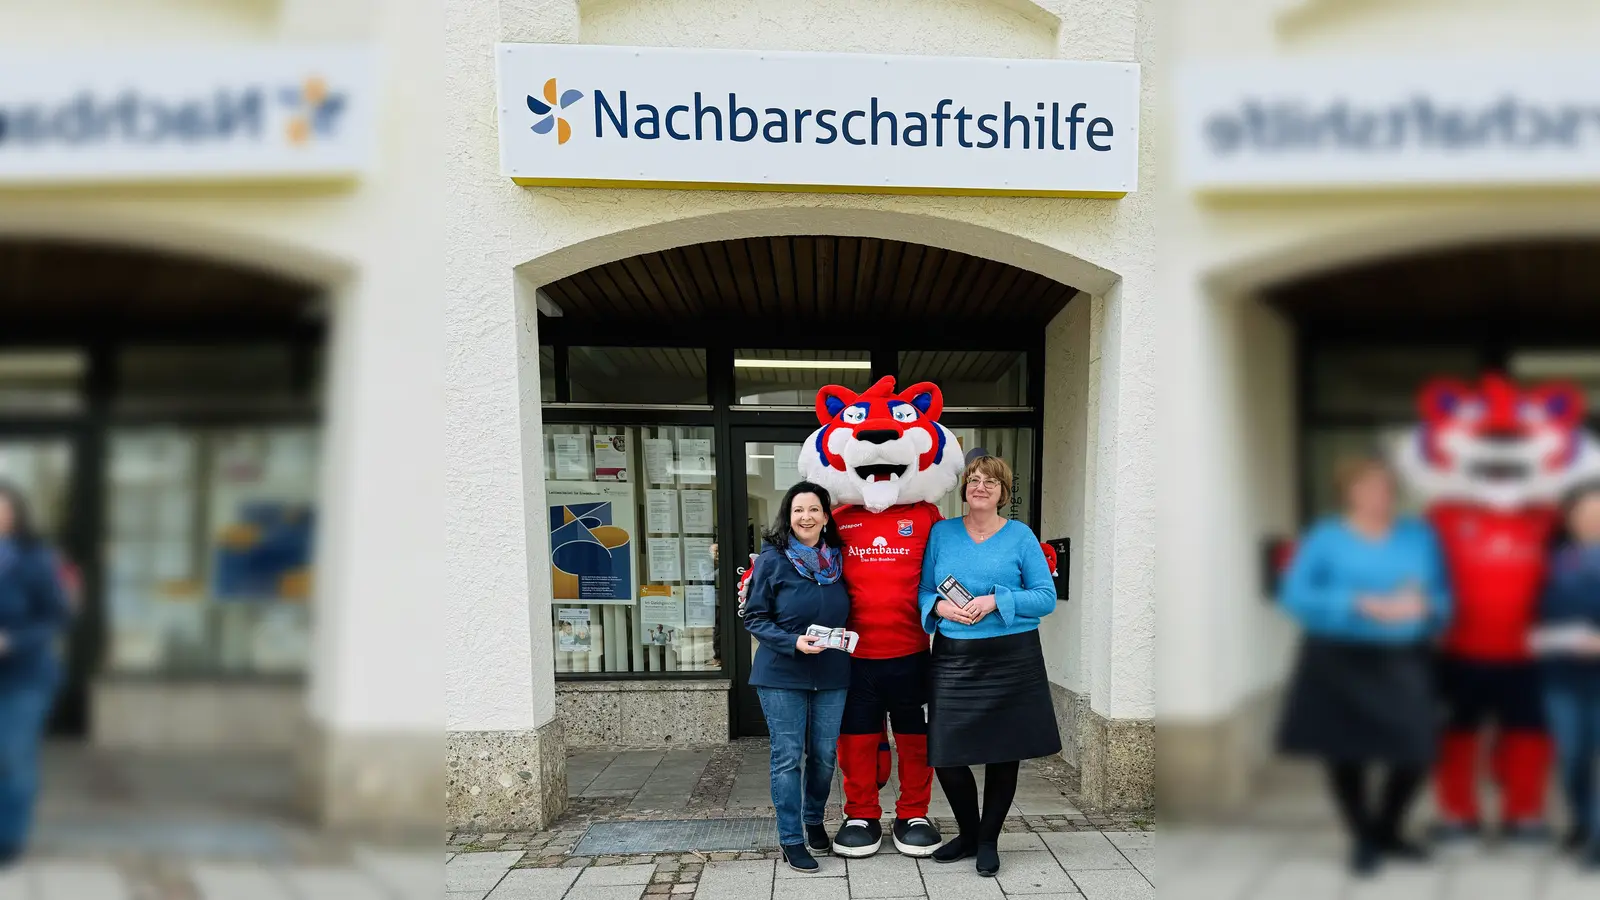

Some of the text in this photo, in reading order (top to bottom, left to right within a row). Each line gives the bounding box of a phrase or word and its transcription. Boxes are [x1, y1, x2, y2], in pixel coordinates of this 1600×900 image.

[594, 89, 1114, 151] Nachbarschaftshilfe
[839, 522, 862, 530] uhlsport
[848, 544, 910, 558] Alpenbauer
